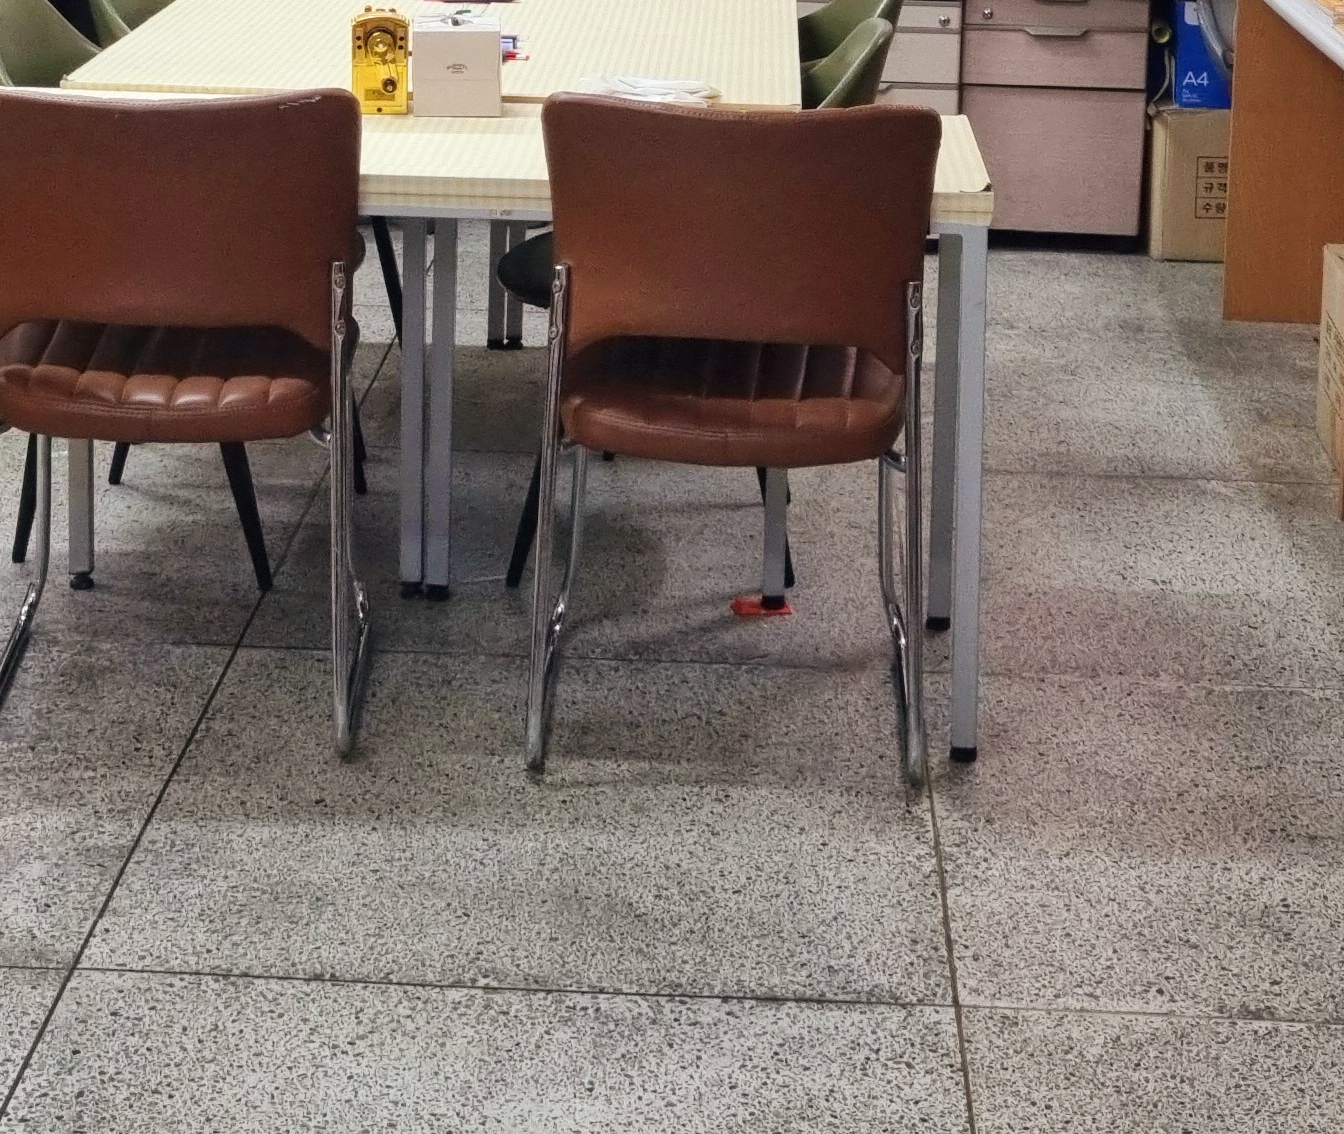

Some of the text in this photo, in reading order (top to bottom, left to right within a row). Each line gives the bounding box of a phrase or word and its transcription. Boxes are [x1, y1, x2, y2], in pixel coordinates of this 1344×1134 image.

[1182, 71, 1210, 87] A4
[1203, 182, 1227, 194] 규격
[1202, 202, 1227, 214] 수량
